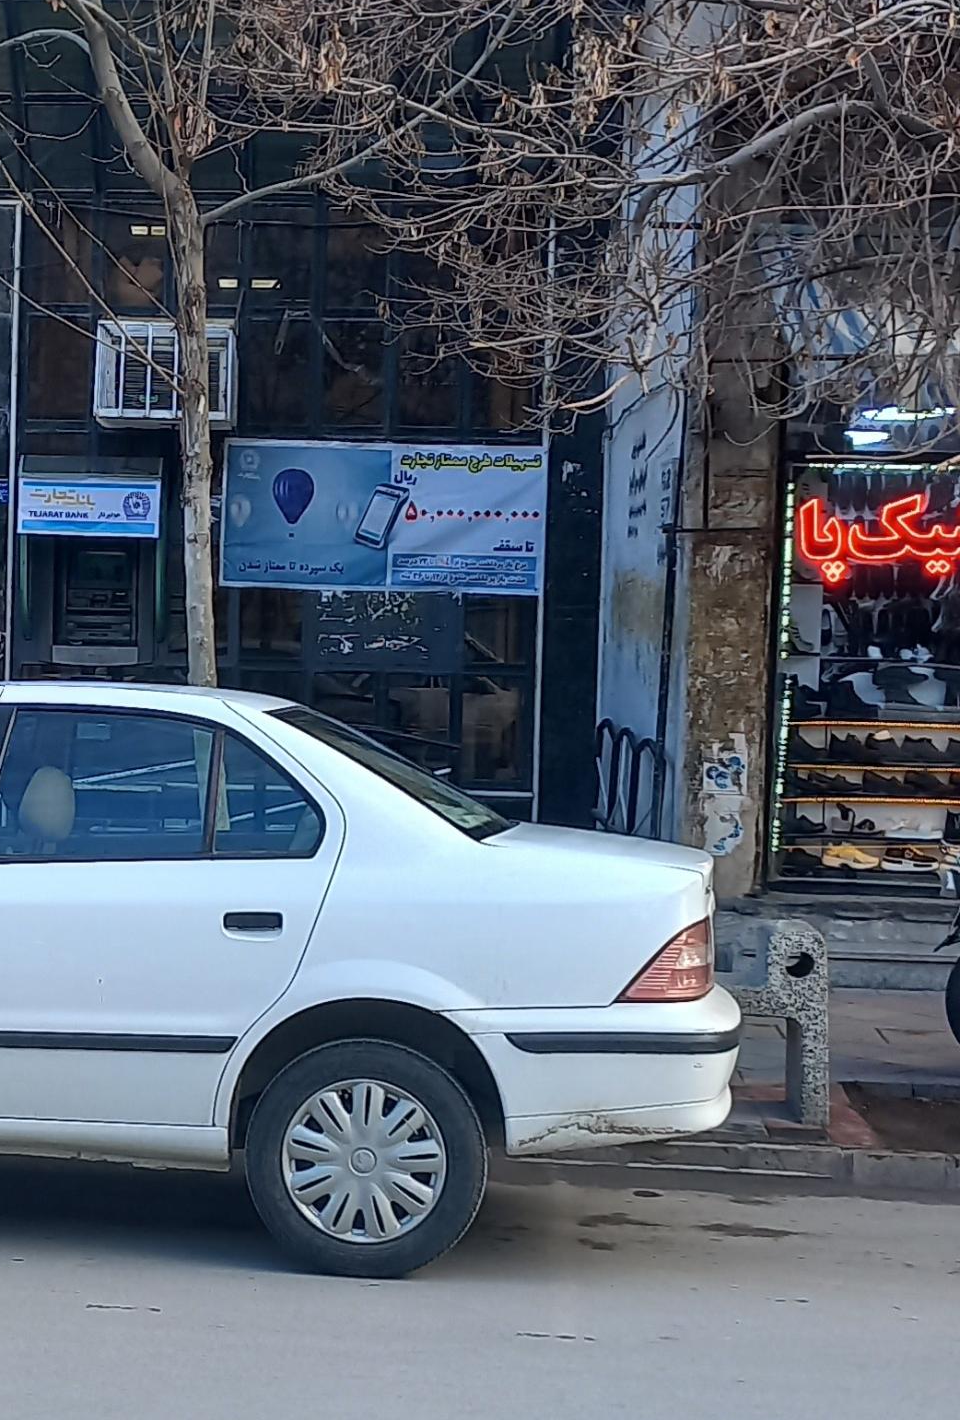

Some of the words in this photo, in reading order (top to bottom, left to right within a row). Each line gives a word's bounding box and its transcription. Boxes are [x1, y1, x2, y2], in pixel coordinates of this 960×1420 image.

[401, 452, 435, 470] تجارت
[434, 452, 468, 471] ممتاز
[468, 453, 492, 473] طرح
[493, 453, 542, 472] تسهیلات
[394, 470, 418, 486] ریال
[29, 488, 76, 504] تجارت
[63, 493, 96, 511] بانک
[28, 510, 64, 519] TEJARAT
[65, 510, 89, 519] BANK
[493, 539, 523, 552] سقف
[525, 540, 535, 552] تا
[800, 498, 845, 582] پا
[239, 560, 261, 572] شدن
[264, 561, 286, 573] ممتاز
[289, 561, 297, 571] تا
[300, 564, 327, 575] سپرده
[329, 562, 344, 574] یک
